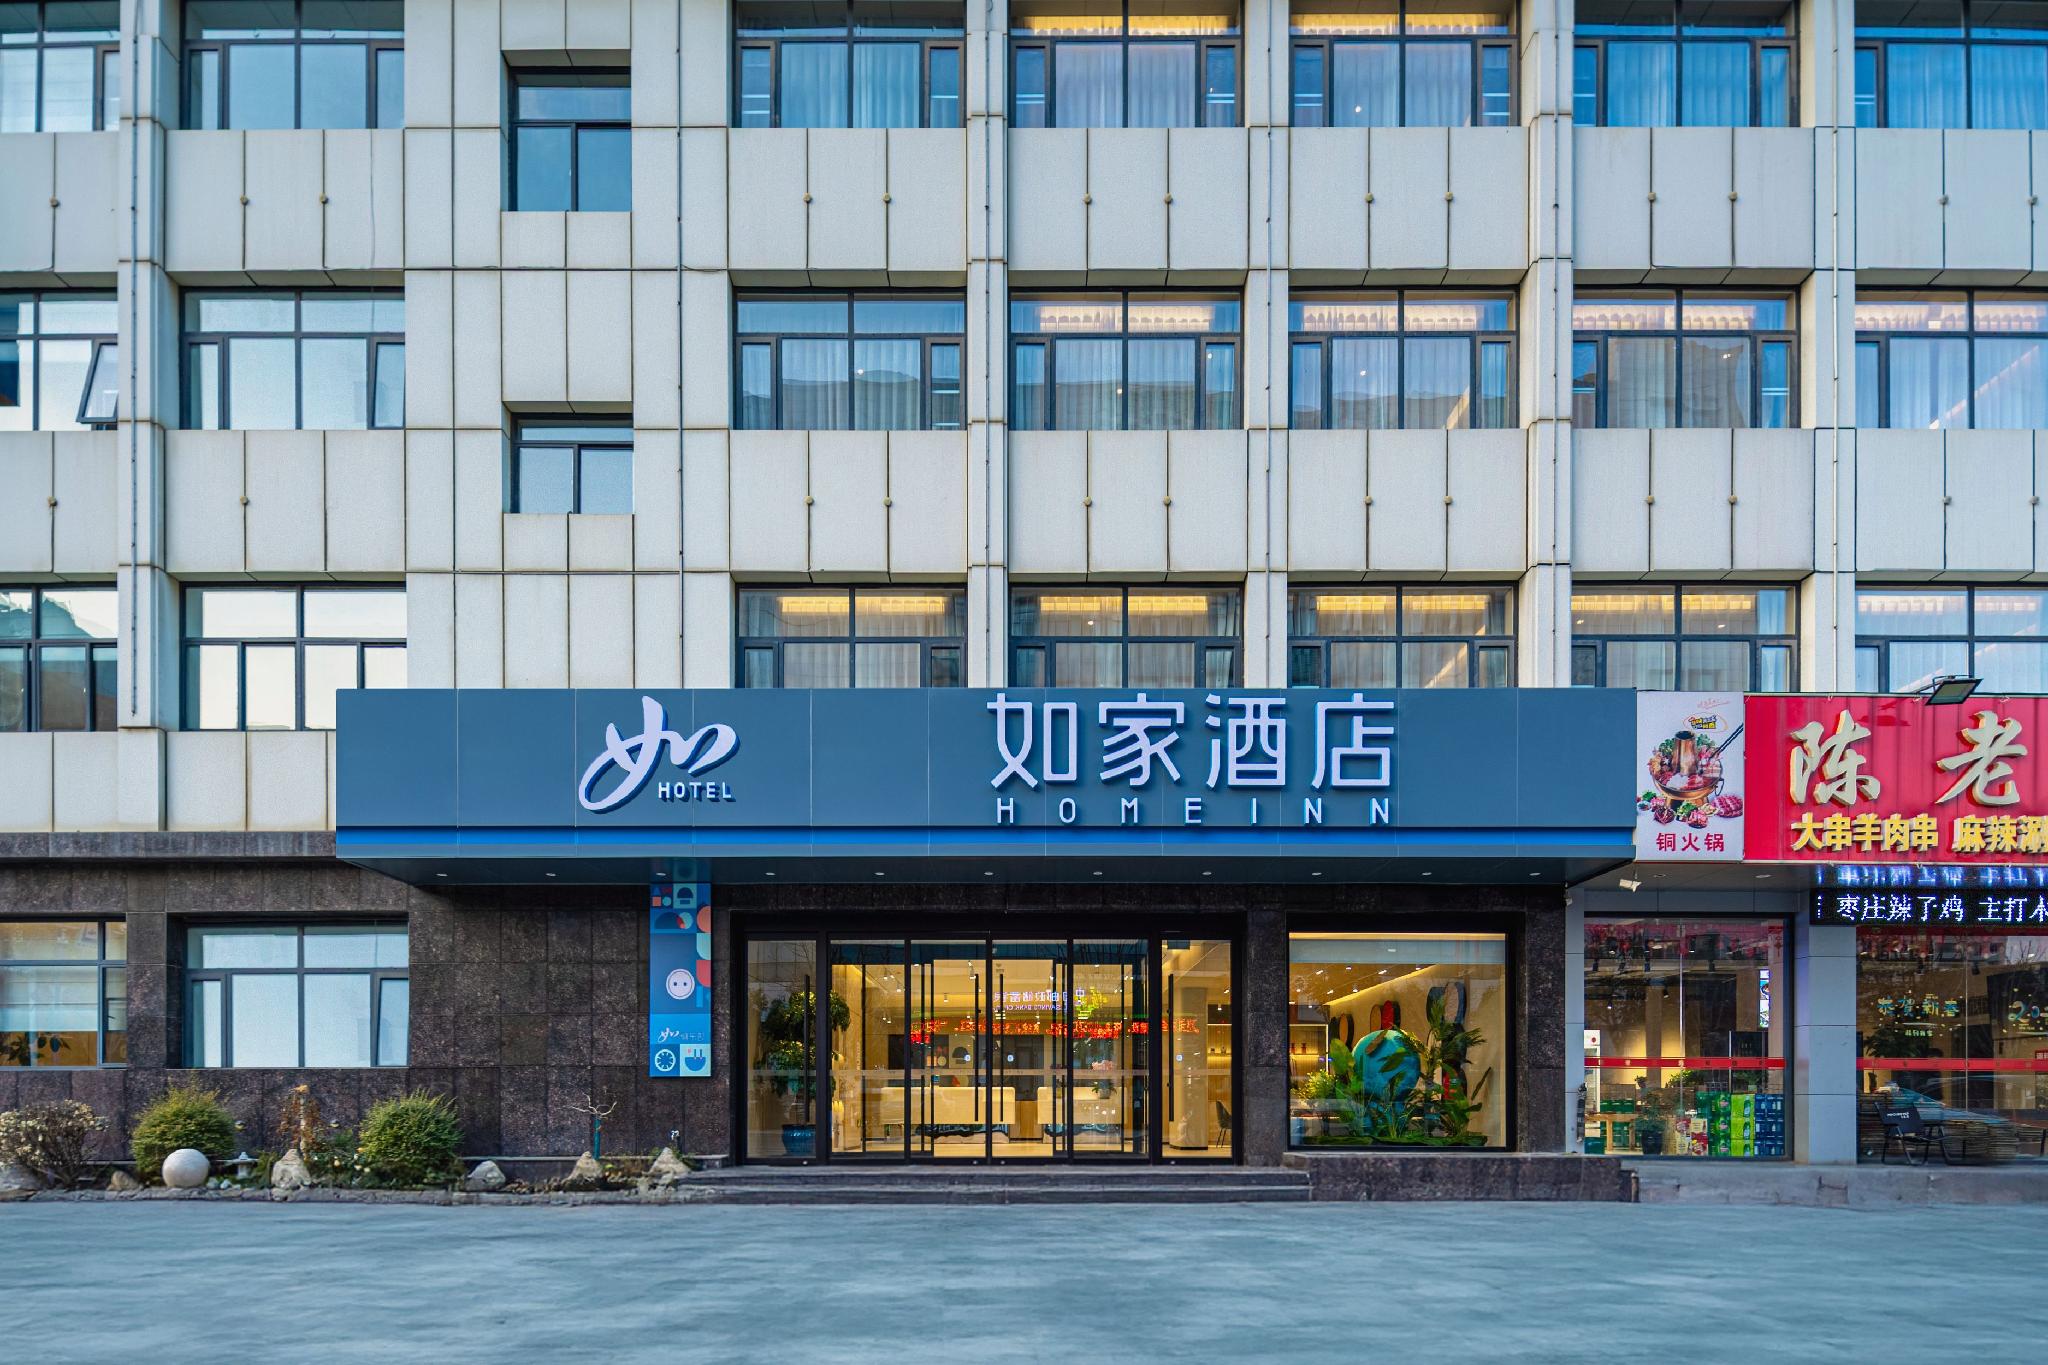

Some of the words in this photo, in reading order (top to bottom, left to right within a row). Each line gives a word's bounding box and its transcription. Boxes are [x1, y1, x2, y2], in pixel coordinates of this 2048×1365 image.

[987, 692, 1397, 790] 如家酒店
[657, 781, 736, 802] HOTEL
[1656, 832, 1726, 853] 铜火锅
[1791, 812, 1940, 853] 大串羊肉串
